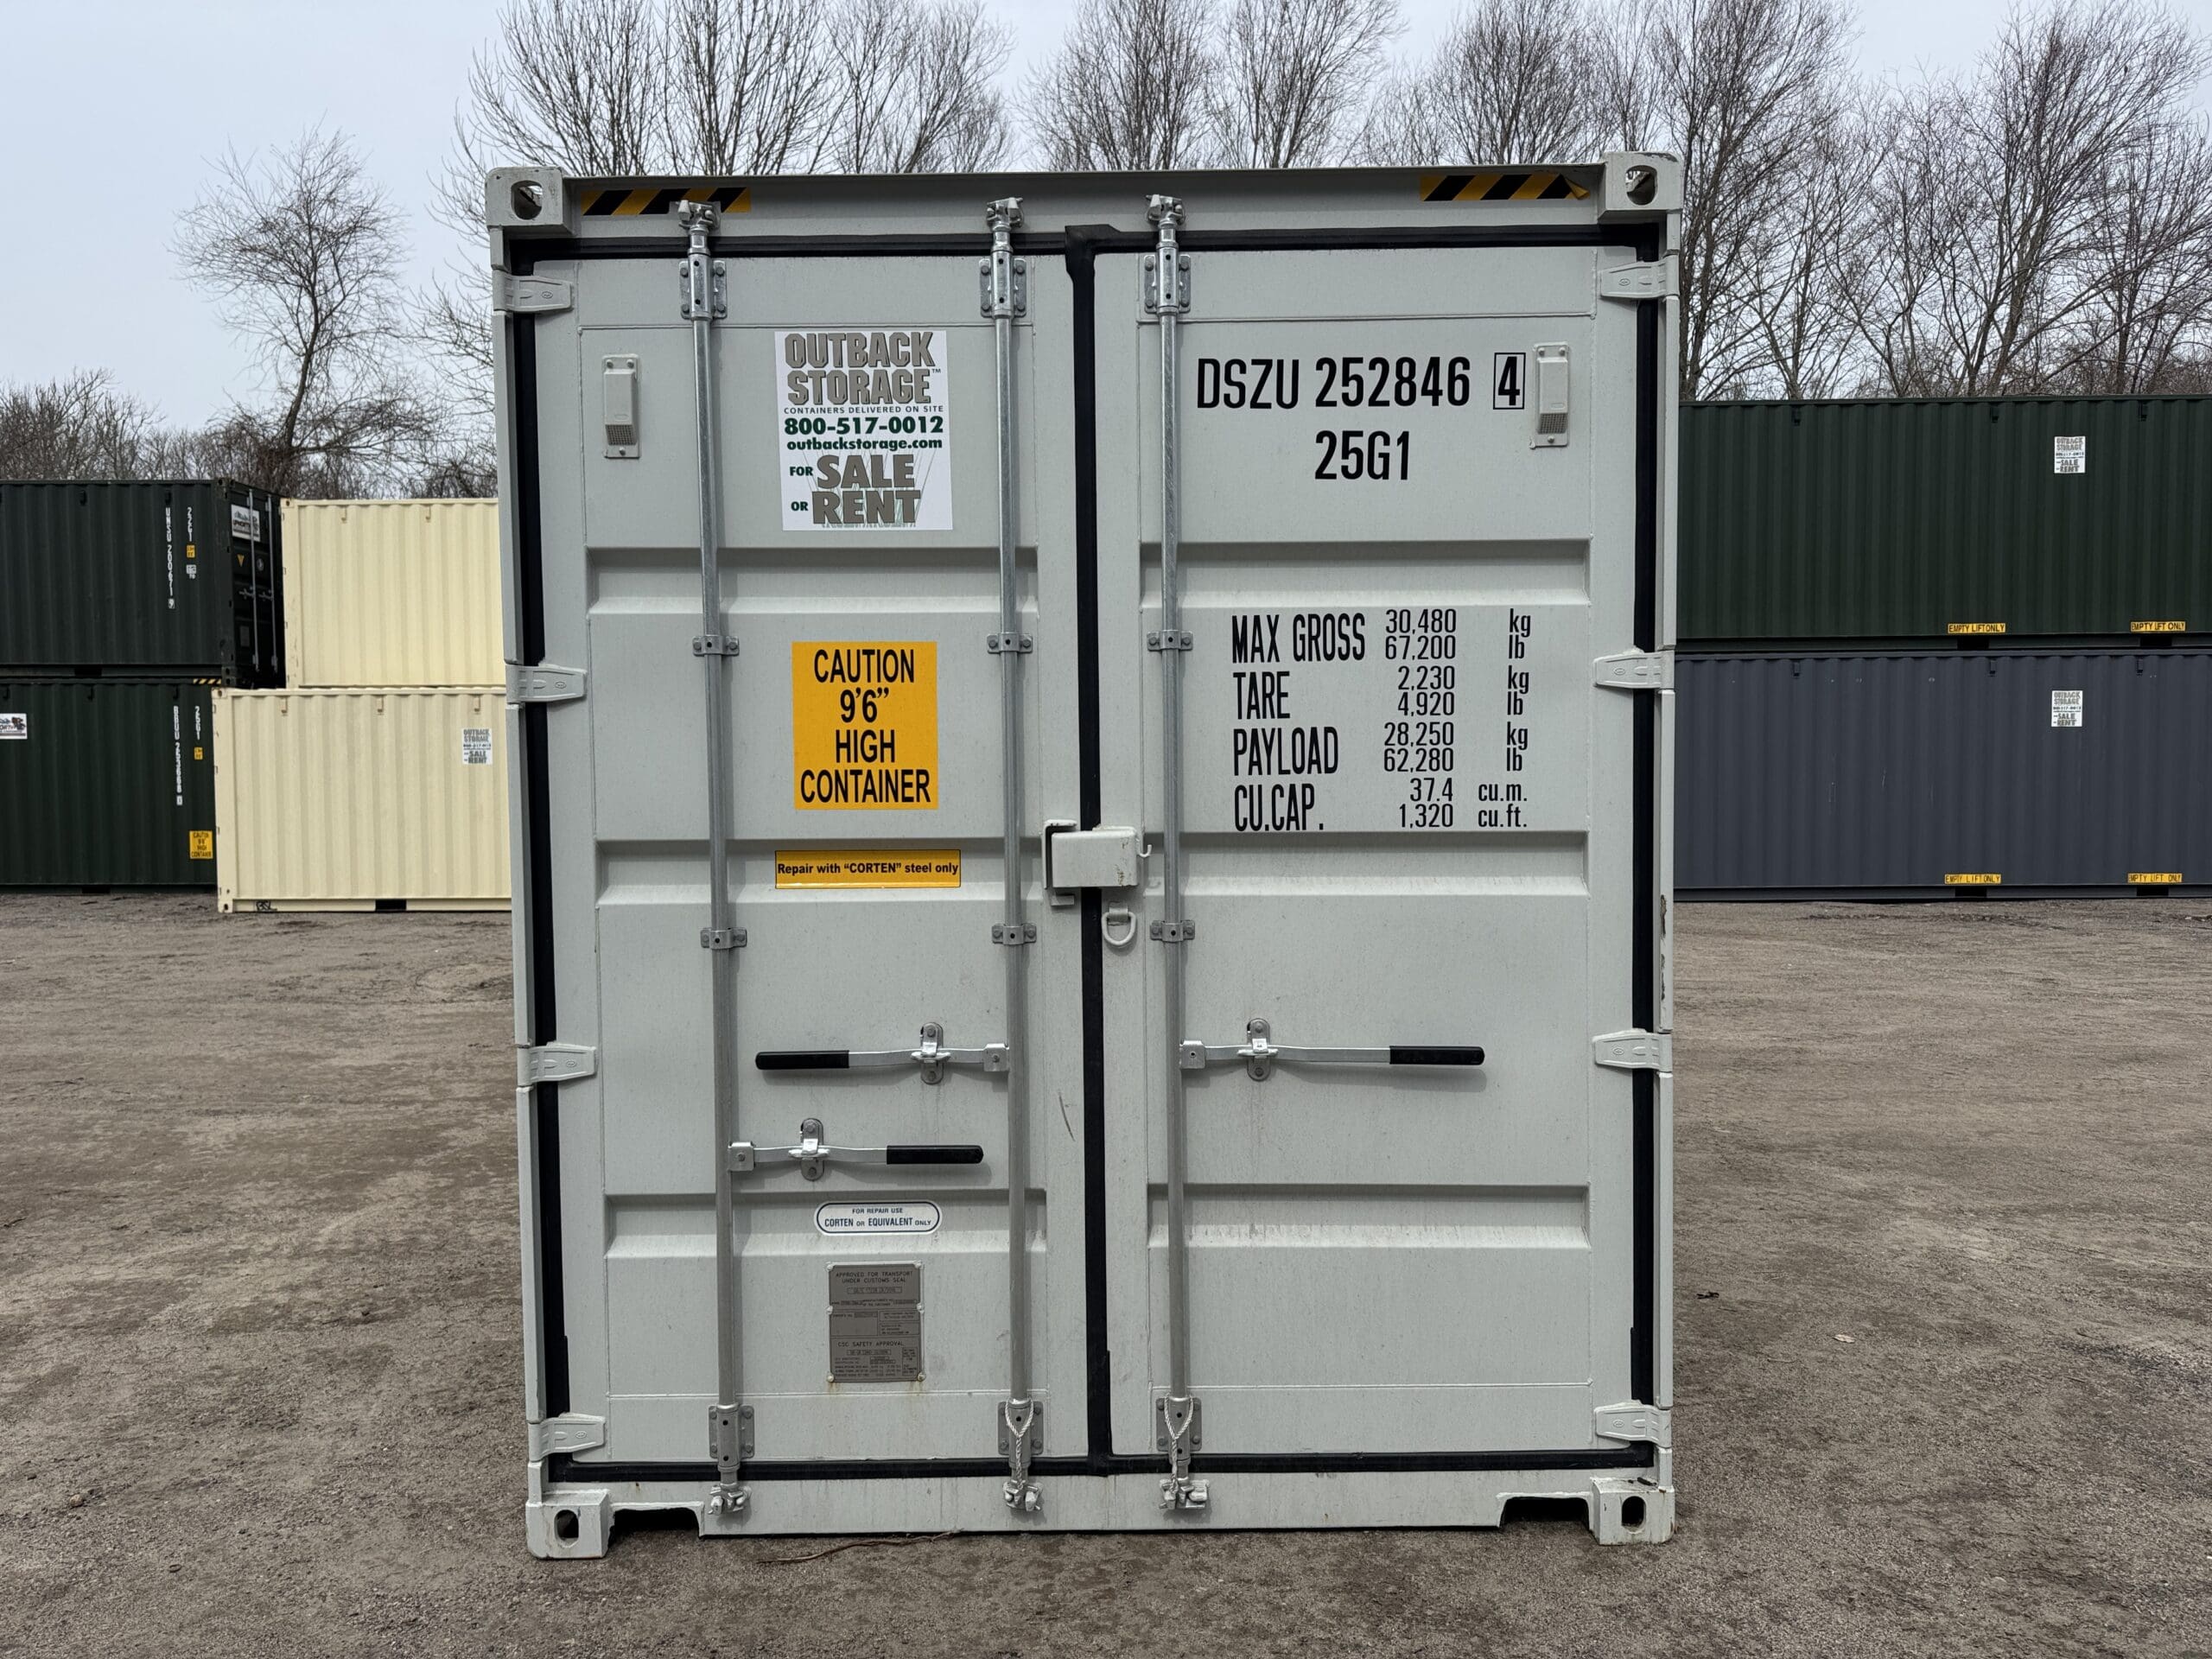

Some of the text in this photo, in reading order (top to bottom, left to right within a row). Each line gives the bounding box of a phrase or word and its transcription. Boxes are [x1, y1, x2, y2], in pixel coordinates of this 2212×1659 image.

[785, 332, 936, 368] OUTBACK
[787, 369, 931, 405] STORAGE
[1198, 356, 1521, 409] DSZU 252846 4
[784, 416, 944, 435] 800-517-0012
[787, 436, 943, 452] outbackstorage.com
[1315, 430, 1409, 480] 25G1
[790, 454, 915, 489] FOR SALE
[791, 490, 921, 524] OR RENT
[1231, 608, 1531, 664] MAX GROSS 30,480 kg
[1385, 635, 1525, 661] 67,200 lb
[814, 649, 914, 683] CAUTION
[1233, 664, 1529, 720] TARE 2,230 kg
[1397, 691, 1523, 716] 4,920 lb
[836, 729, 895, 763] HIGH
[1233, 721, 1529, 776] PAYLOAD 28,250 kg
[1383, 747, 1522, 773] 62,280 lb
[800, 769, 931, 803] CONTAINER
[1234, 778, 1528, 832] CU.CAP. 37.4 cu.m.
[1399, 804, 1528, 829] 1,320 cu.ft.
[778, 863, 813, 876] Repair
[817, 863, 841, 874] with
[905, 862, 931, 873] steel
[935, 862, 958, 875] only
[824, 1218, 854, 1227] CORTEN
[868, 1217, 913, 1226] EQUIVALENT
